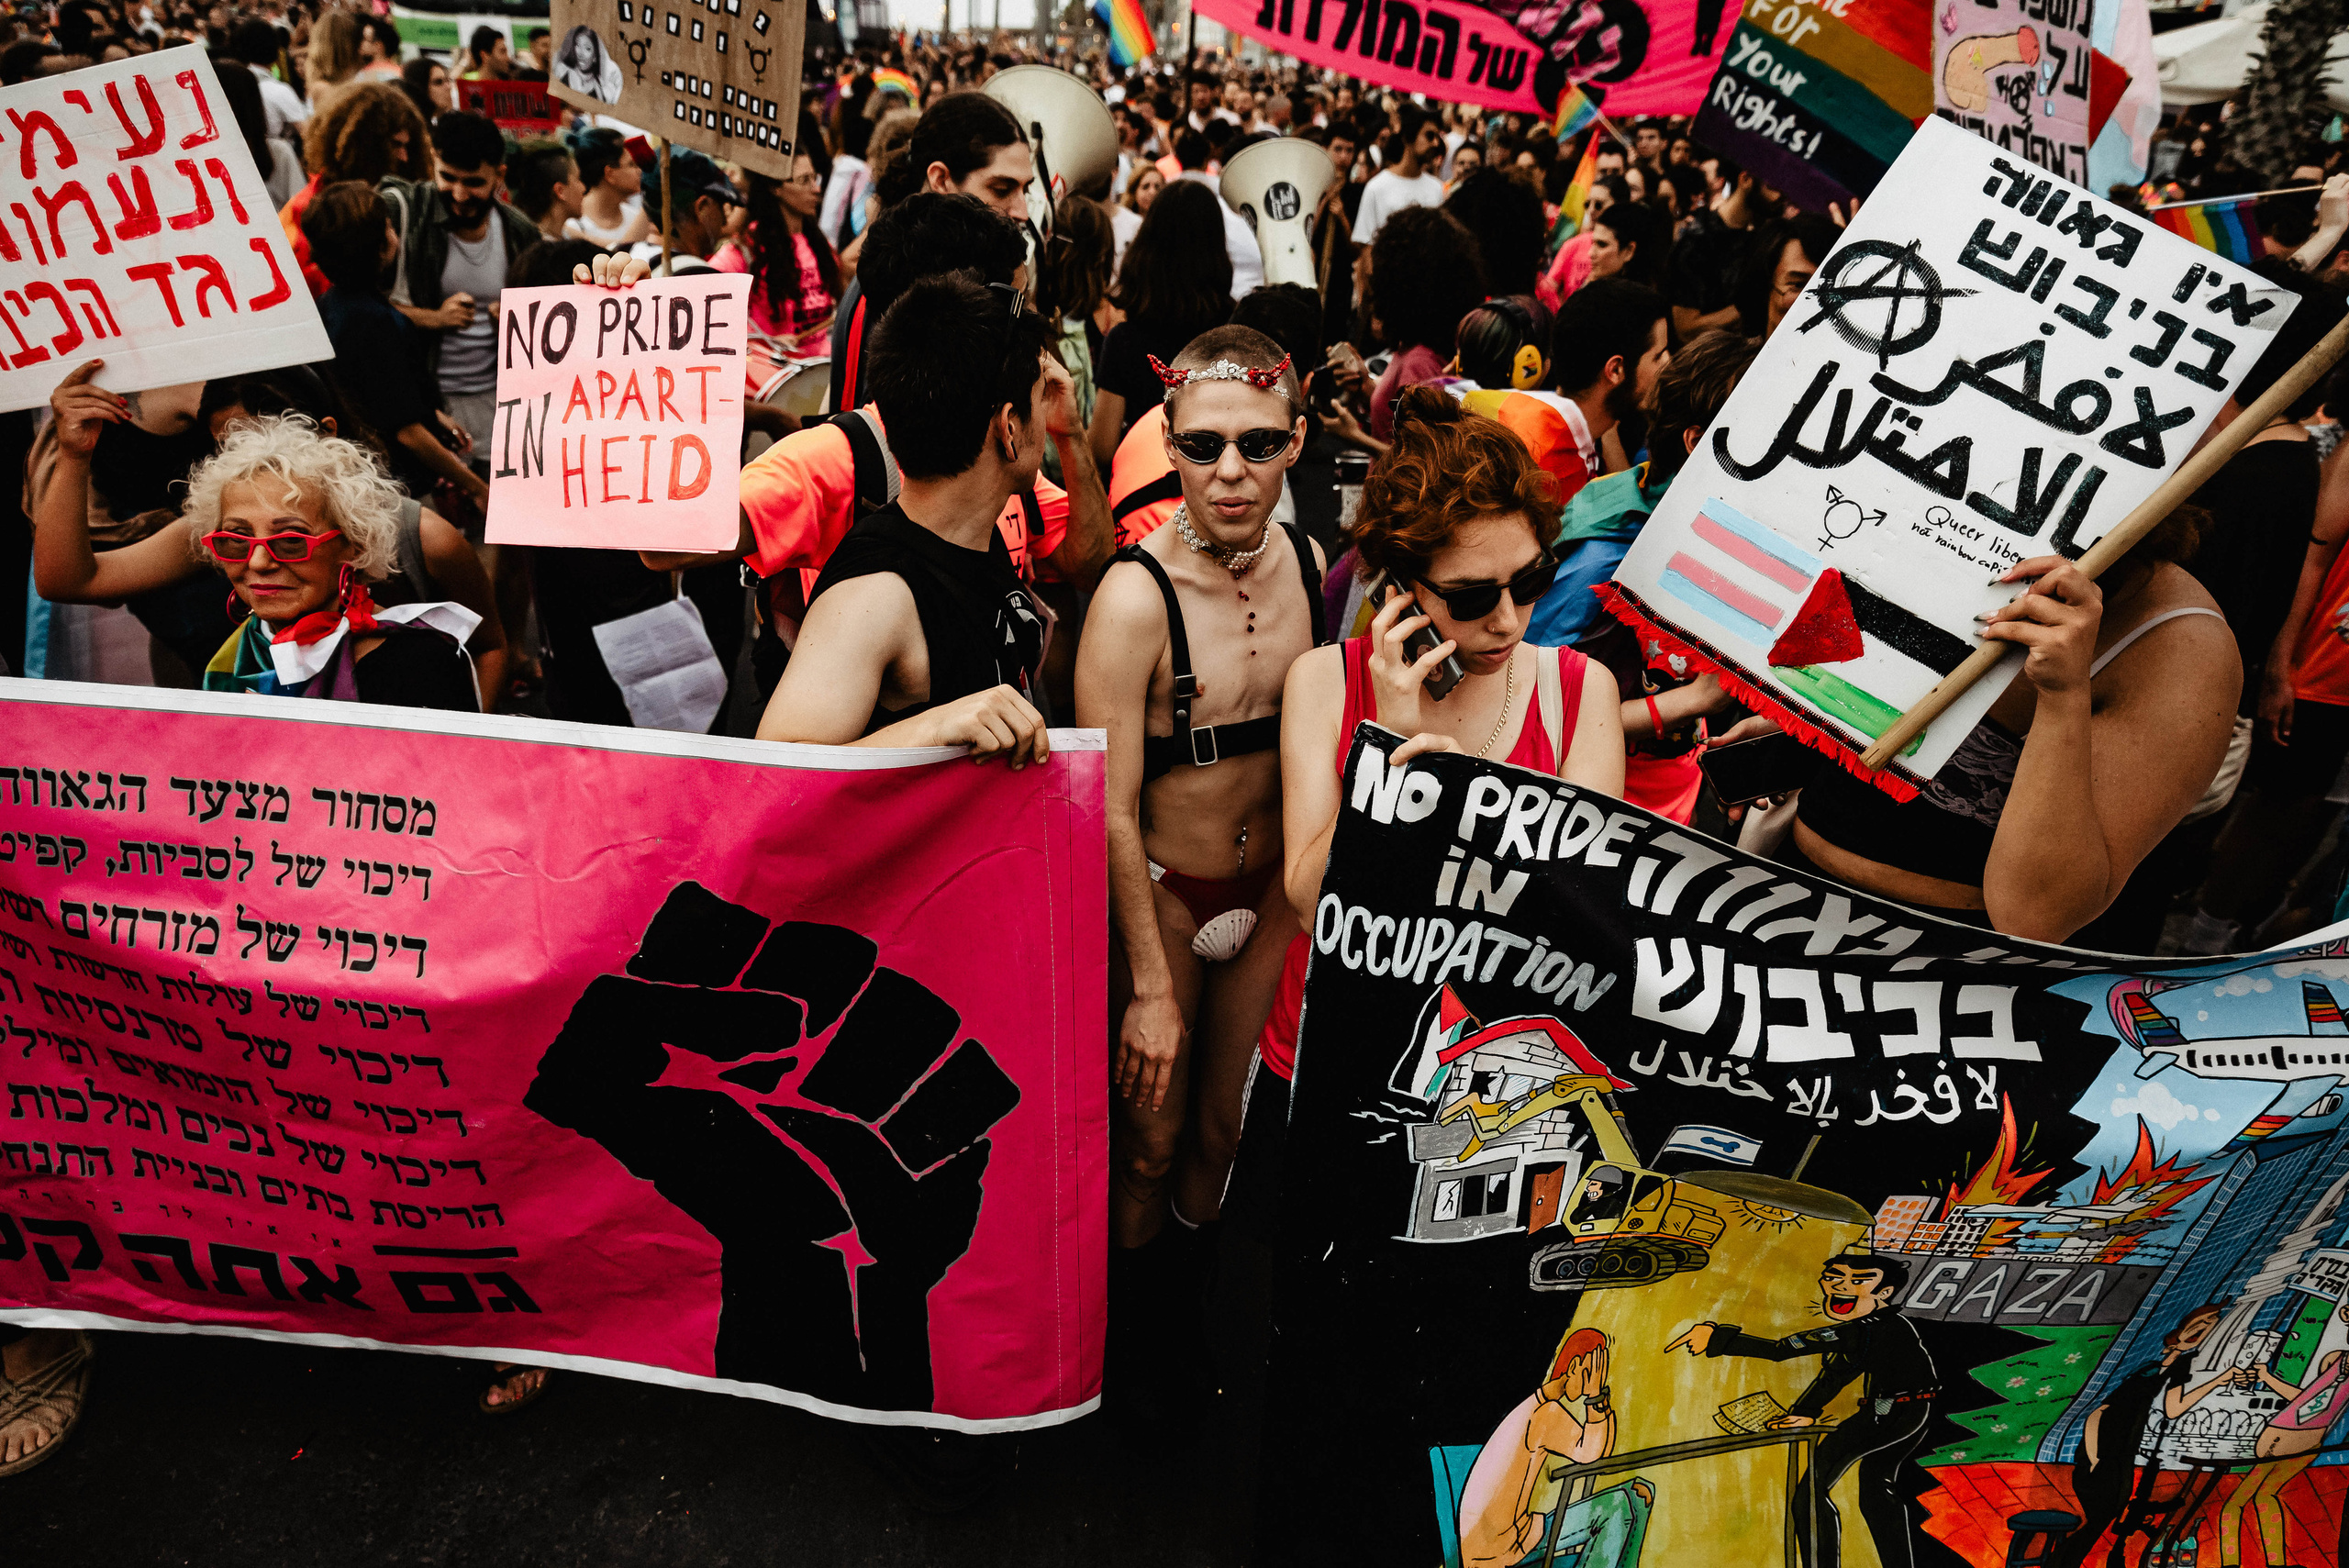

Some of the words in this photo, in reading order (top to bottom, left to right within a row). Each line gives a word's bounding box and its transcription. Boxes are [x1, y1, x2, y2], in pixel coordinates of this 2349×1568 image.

[1468, 31, 1529, 92] של
[1712, 75, 1822, 160] Rights!
[1982, 157, 2143, 268] גאווה
[127, 237, 292, 328] נגד
[2172, 262, 2276, 328] אין
[506, 300, 577, 369] NO
[597, 293, 737, 359] PRIDE
[562, 366, 734, 424] APART-
[495, 392, 551, 479] IN
[562, 433, 712, 508] HEID
[1925, 506, 1985, 542] Queer
[1988, 536, 2026, 565] liber
[1934, 535, 1976, 562] rainbow
[0, 766, 148, 813] הגאווה
[170, 775, 291, 824] מצעד
[1351, 742, 1442, 824] NO
[312, 786, 437, 837] מסחור
[105, 835, 254, 884] לסביות,
[271, 839, 326, 889] של
[344, 856, 432, 901] דיכוי
[60, 898, 220, 956] מזרחים
[236, 904, 301, 963] של
[318, 924, 429, 979] דיכוי
[33, 982, 203, 1053] טרנסיות
[156, 971, 252, 1016] עולות
[264, 980, 320, 1021] של
[334, 997, 431, 1033] דיכוי
[1631, 937, 2043, 1064] בכיבוש
[217, 1018, 292, 1070] של
[318, 1043, 451, 1088] דיכוי
[106, 1047, 260, 1106] הומואים
[266, 1076, 331, 1120] של
[7, 1077, 167, 1135] ומלכות
[176, 1105, 275, 1157] נכים
[353, 1100, 468, 1137] דיכוי
[0, 1141, 114, 1178] התנח
[131, 1147, 247, 1197] ובניית
[276, 1122, 346, 1174] של
[361, 1150, 486, 1185] דיכוי
[257, 1174, 354, 1221] בתים
[370, 1199, 505, 1229] הריסת
[118, 1232, 375, 1313] אתה
[389, 1271, 542, 1314] גם
[1906, 1261, 2107, 1322] GAZA
